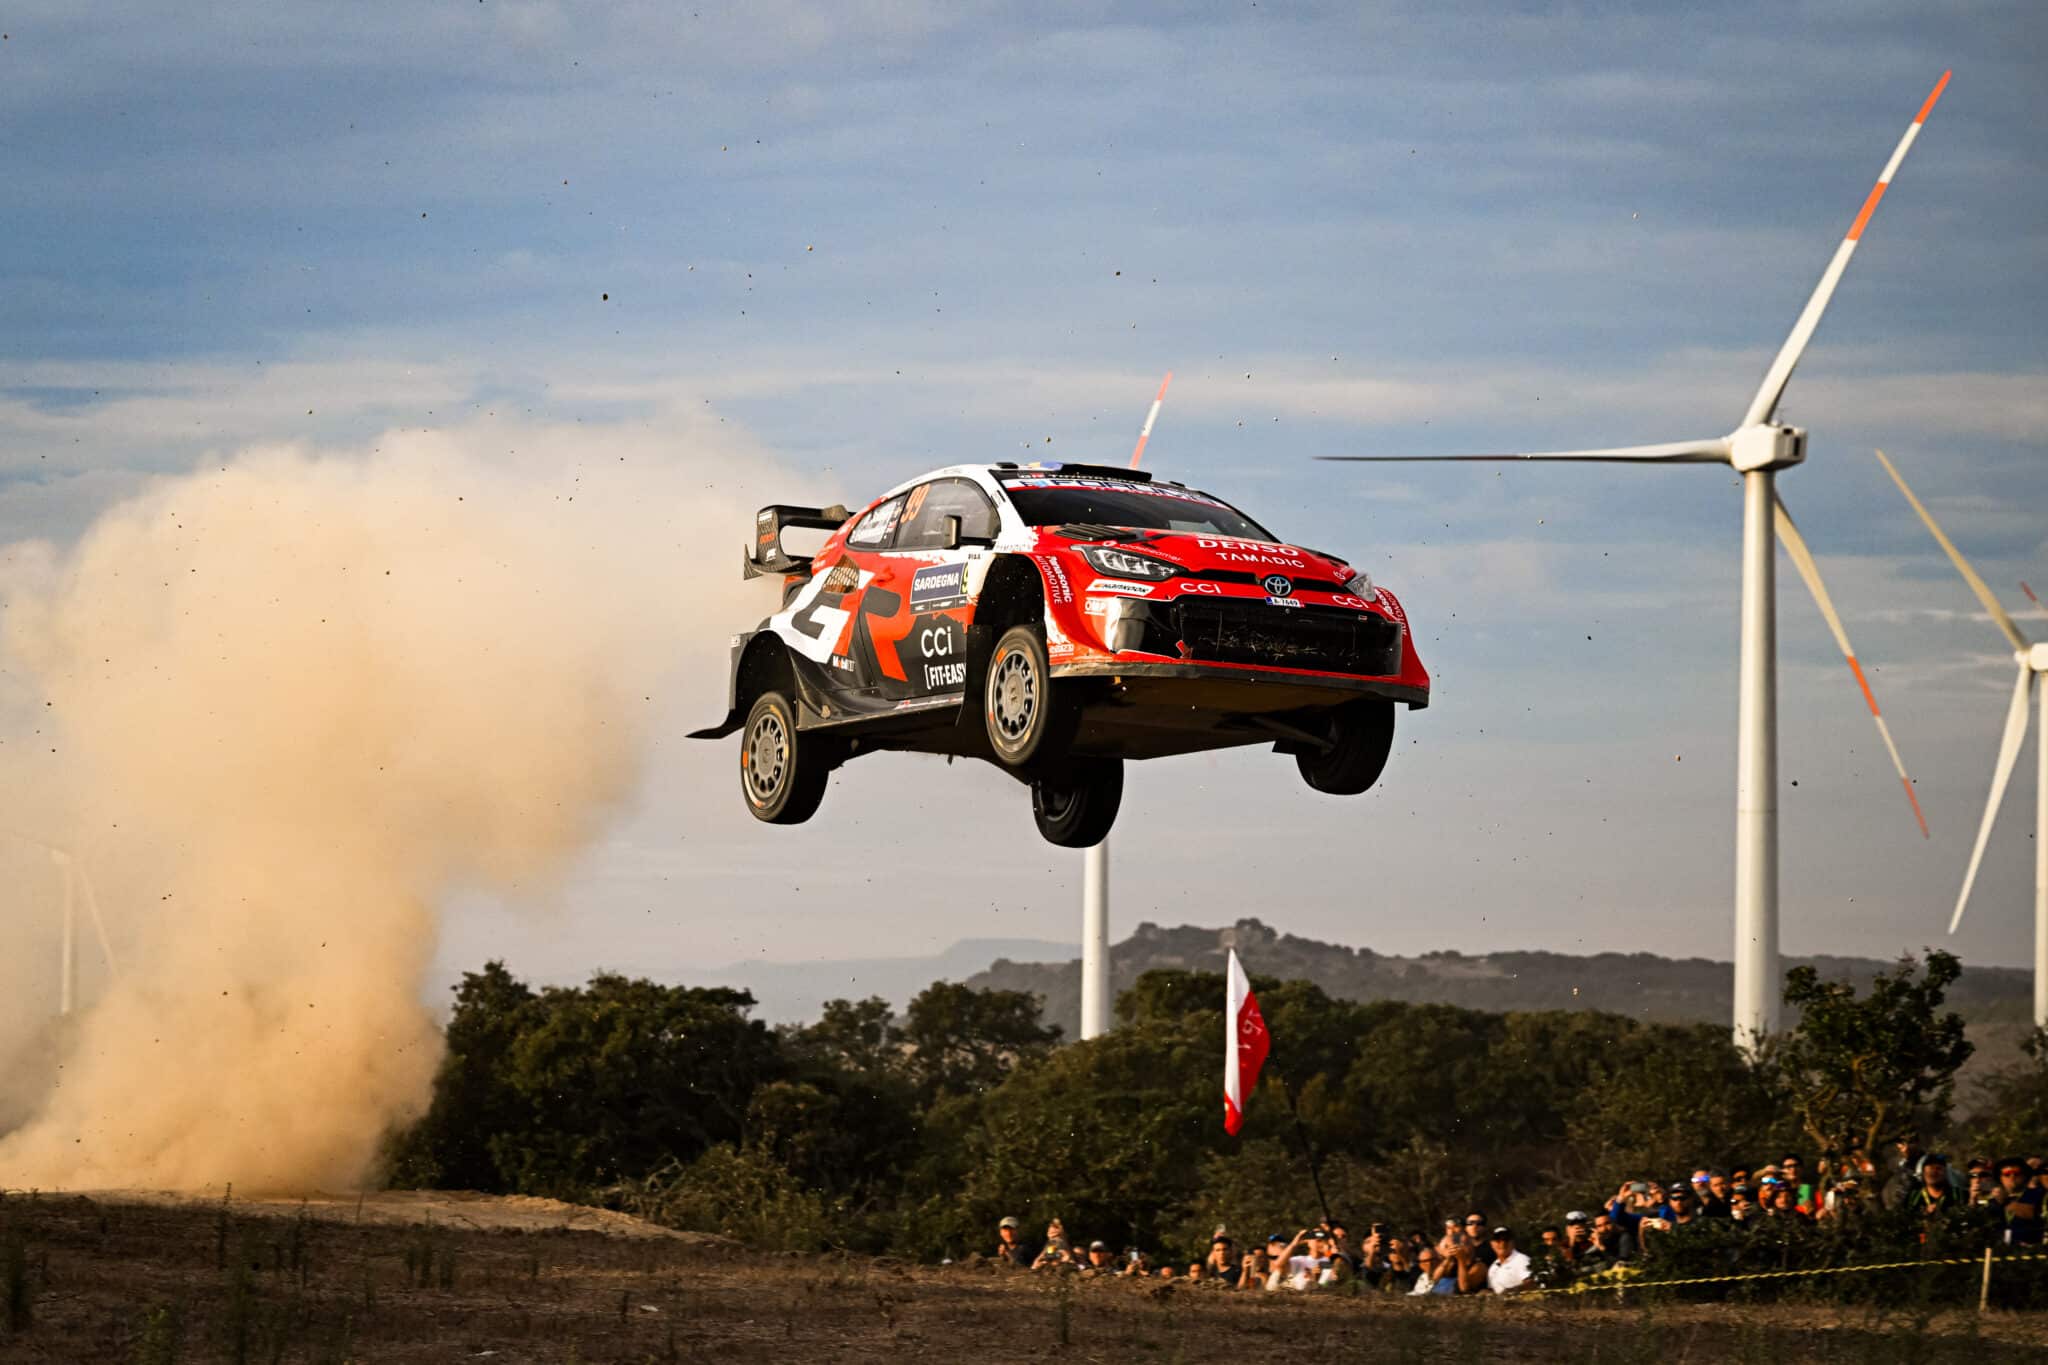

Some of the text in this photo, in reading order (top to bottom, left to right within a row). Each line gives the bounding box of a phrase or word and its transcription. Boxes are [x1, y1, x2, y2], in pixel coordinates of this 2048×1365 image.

[1197, 539, 1299, 557] DENSO
[1216, 552, 1305, 568] TAMADIC
[914, 572, 960, 592] SARDEGNA
